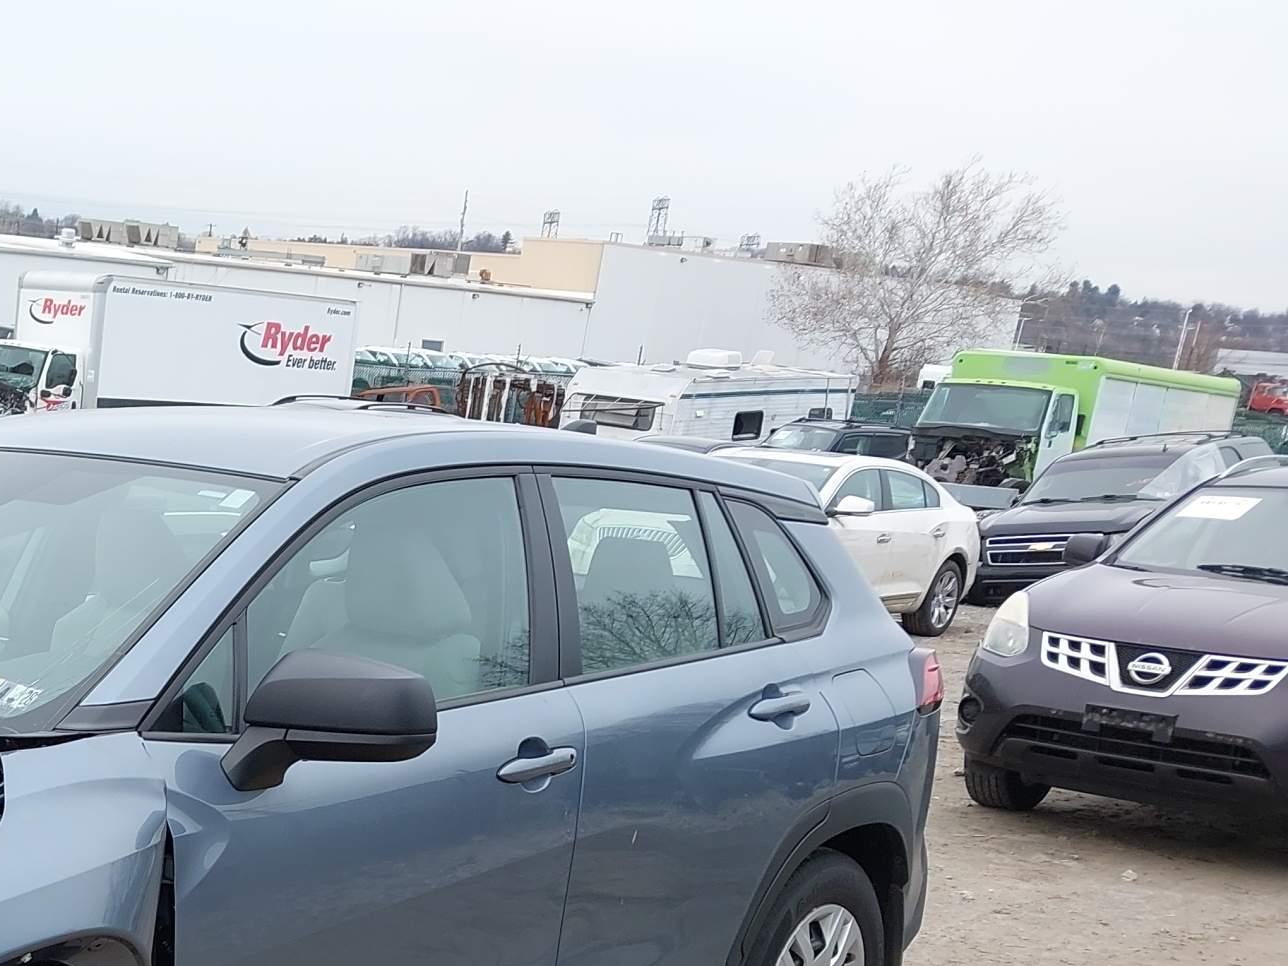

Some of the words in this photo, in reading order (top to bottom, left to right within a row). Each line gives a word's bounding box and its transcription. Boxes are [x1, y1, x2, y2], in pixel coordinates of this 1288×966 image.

[41, 298, 87, 319] Ryder
[260, 321, 333, 357] Ryder
[285, 354, 308, 369] Ever
[308, 355, 337, 371] better.
